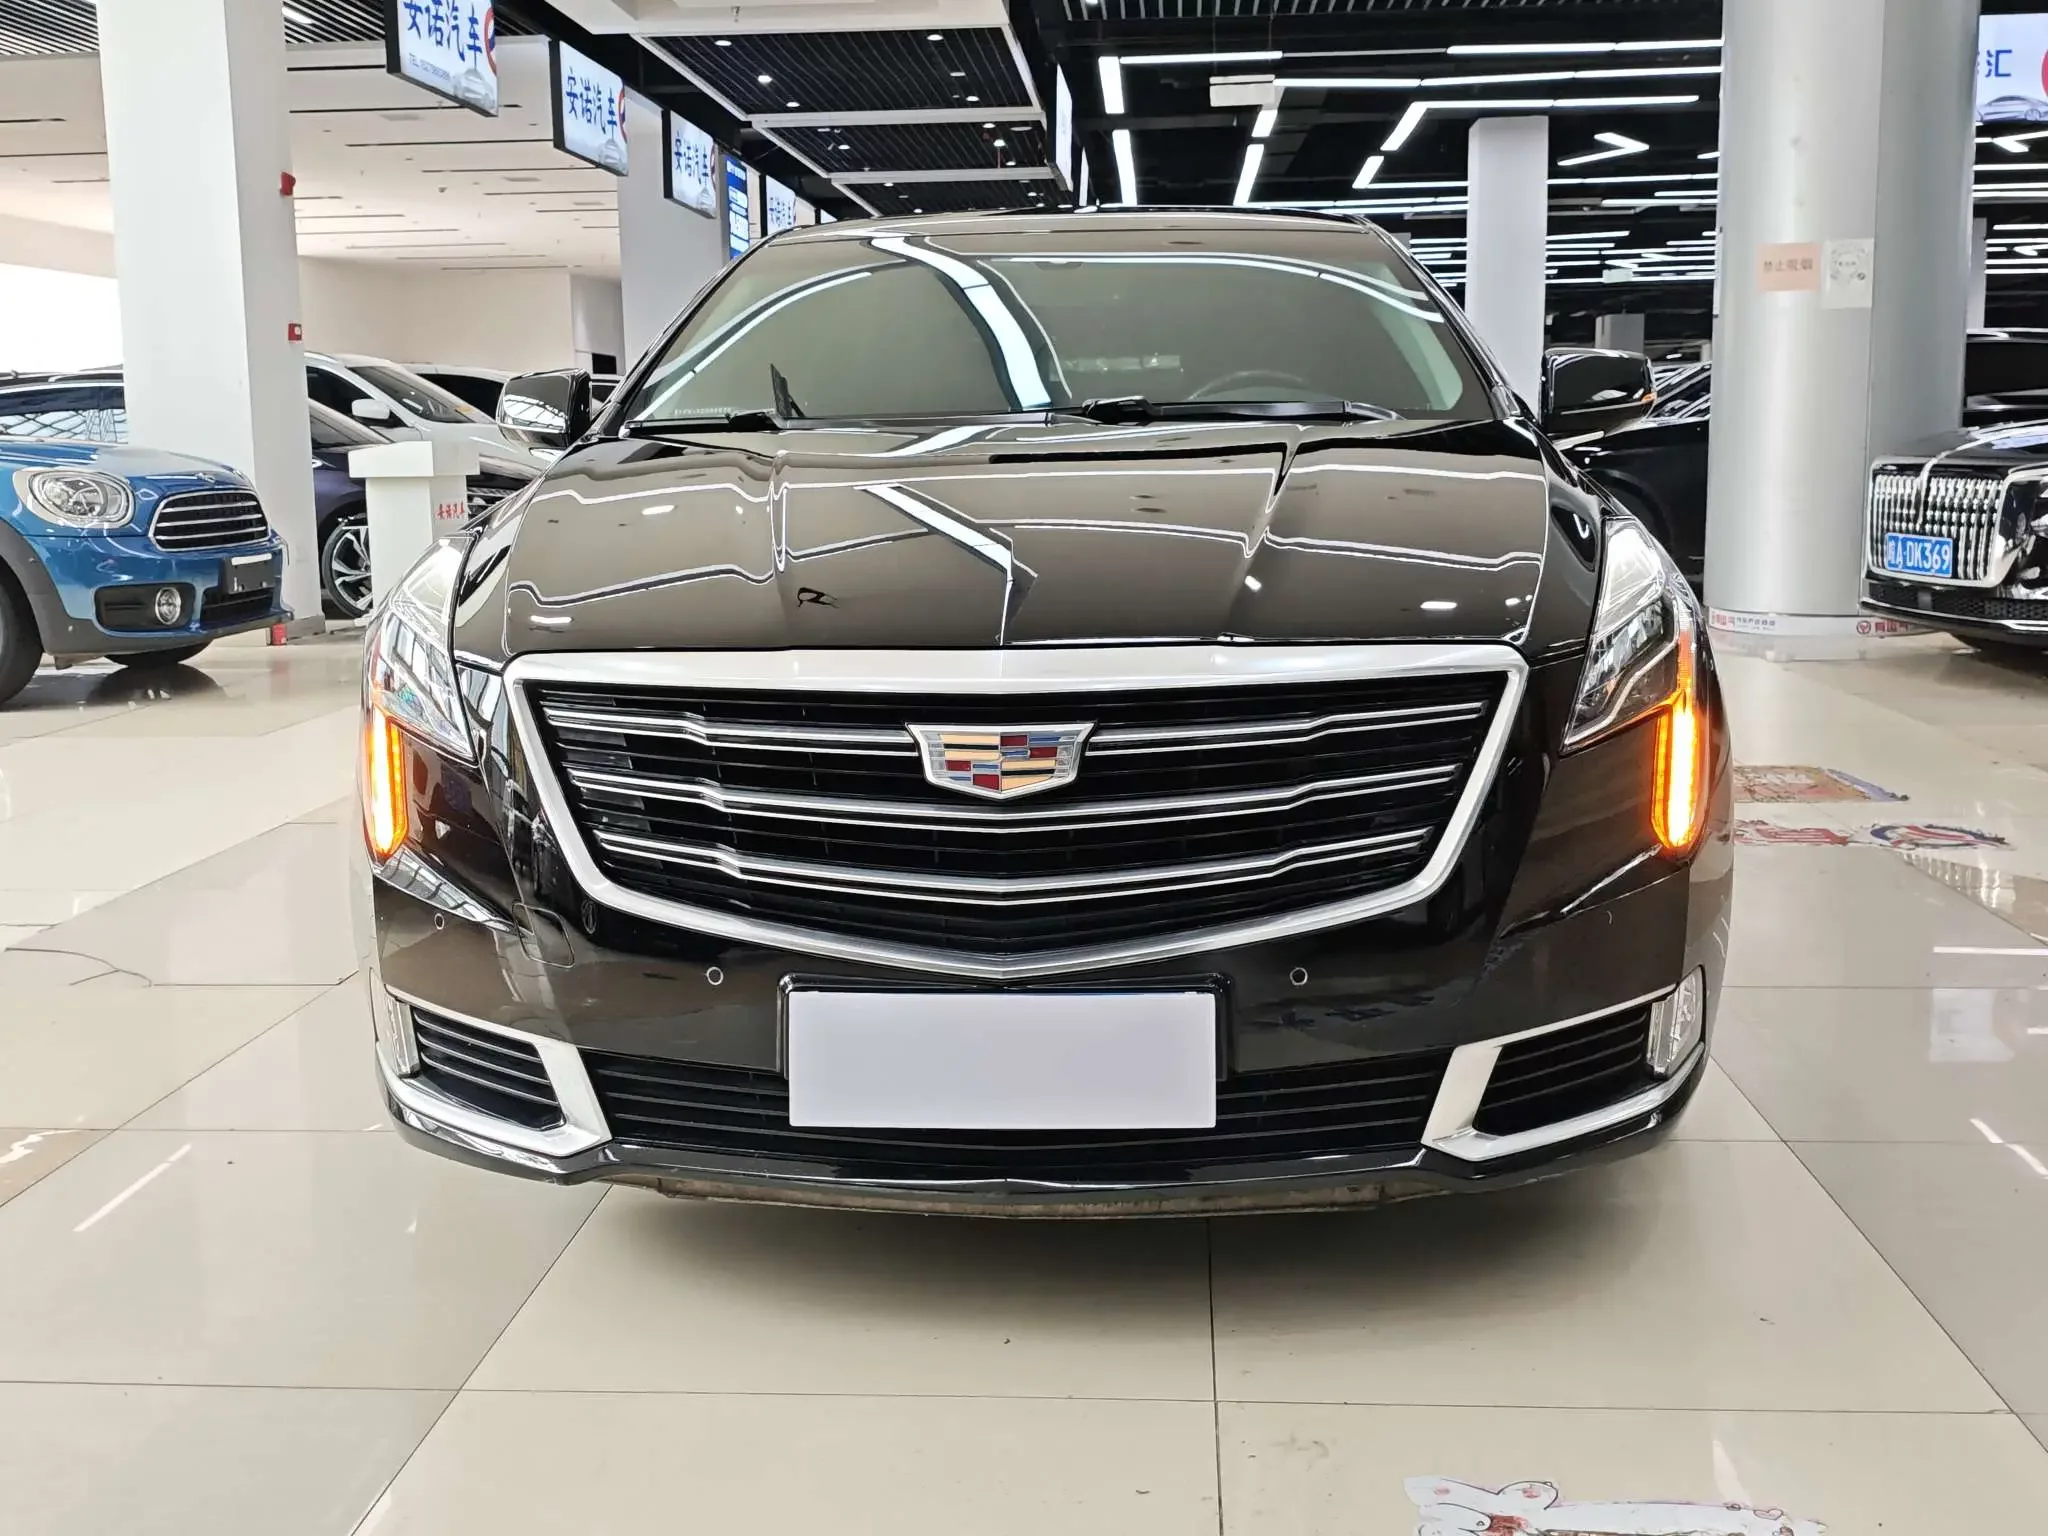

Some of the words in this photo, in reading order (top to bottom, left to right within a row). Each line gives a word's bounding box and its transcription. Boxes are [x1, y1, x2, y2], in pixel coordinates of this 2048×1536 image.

[403, 0, 483, 71] 安诺汽车
[1976, 49, 2013, 78] 汇
[566, 65, 618, 140] 安诺汽车
[674, 130, 709, 186] 安诺汽车
